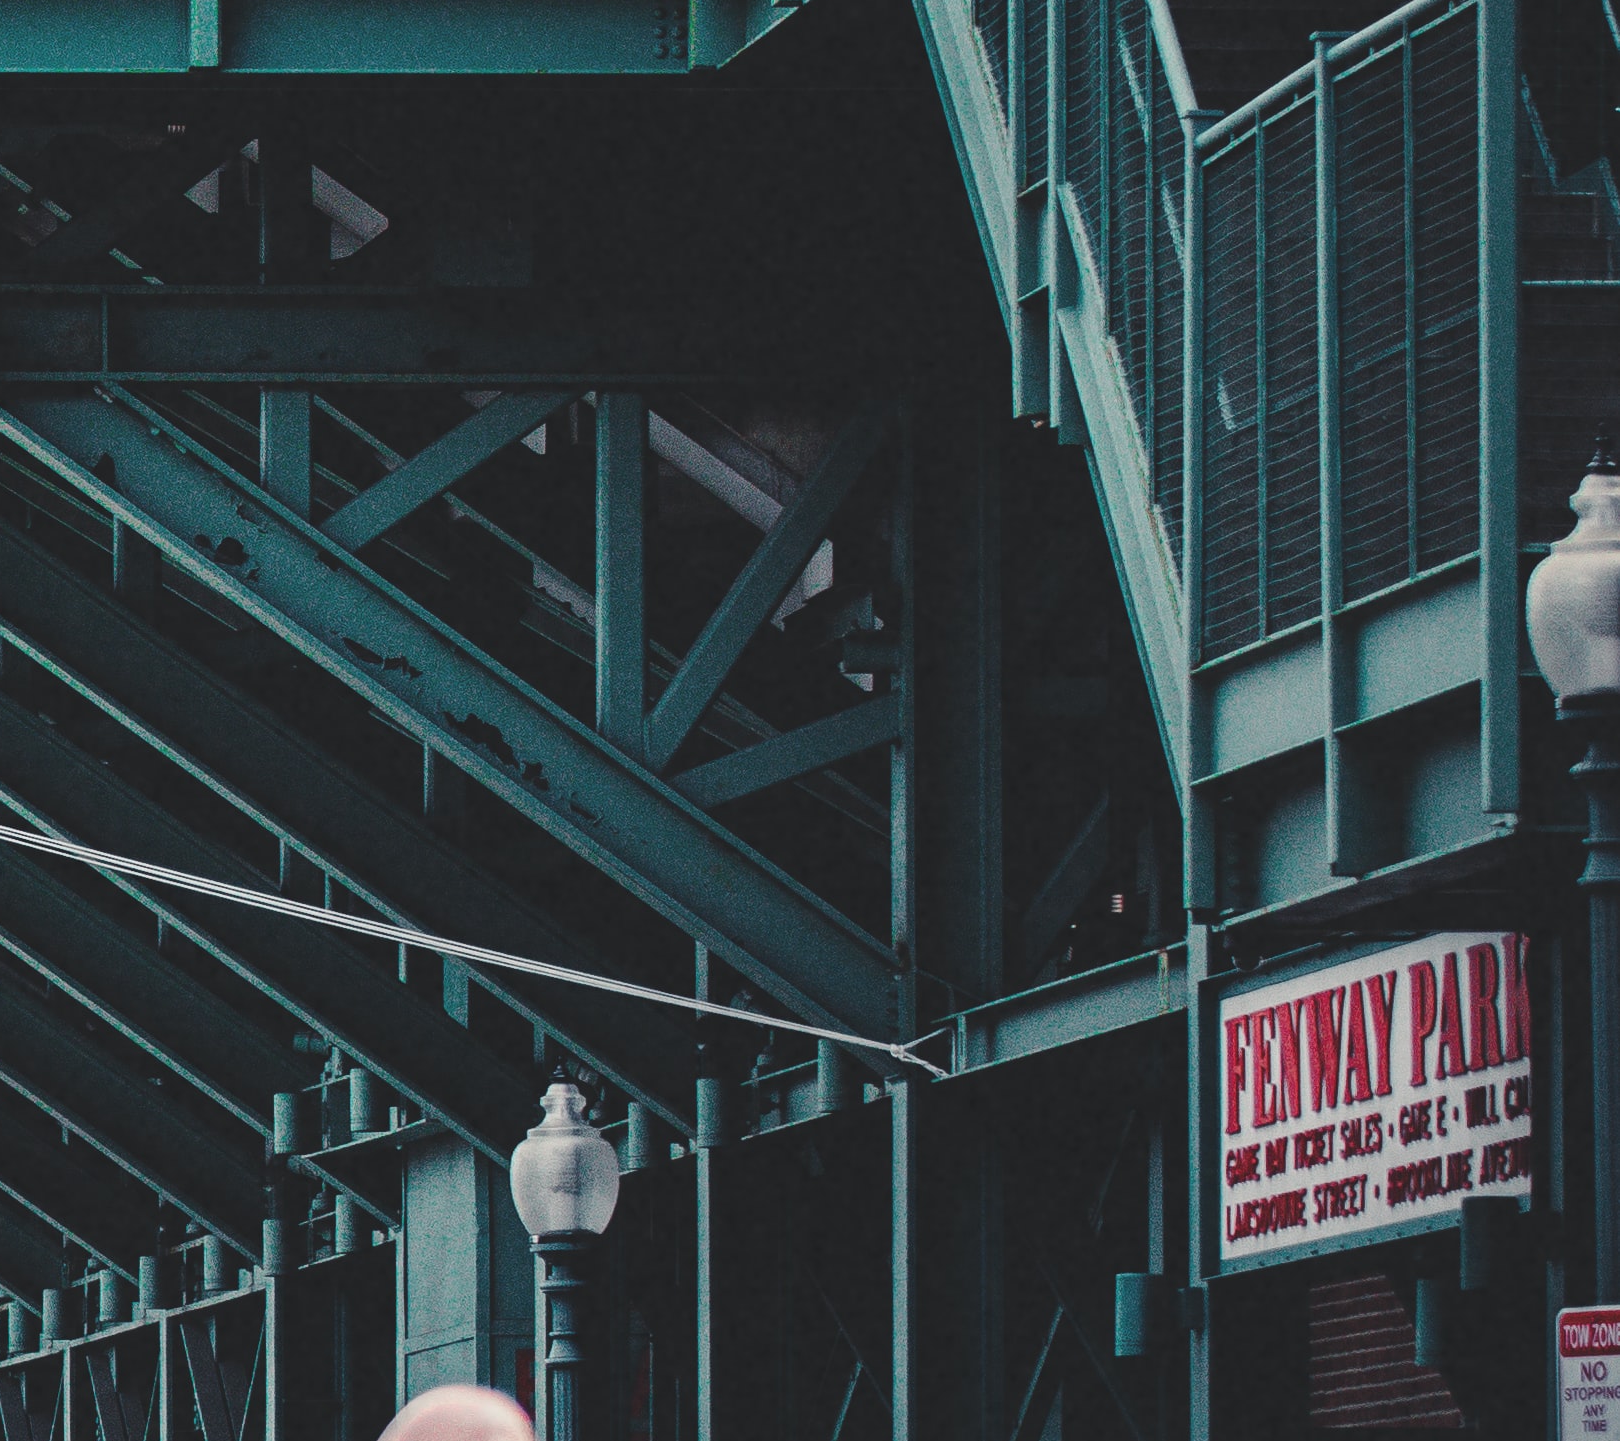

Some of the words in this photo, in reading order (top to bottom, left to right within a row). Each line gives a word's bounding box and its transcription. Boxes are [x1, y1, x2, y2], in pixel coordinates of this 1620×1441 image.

[1224, 969, 1397, 1135] FENWAY
[1408, 932, 1531, 1087] PARK
[1340, 1113, 1383, 1160] SALES
[1313, 1173, 1367, 1223] STREET
[1563, 1324, 1589, 1349] TOW
[1580, 1360, 1607, 1382] NO
[1582, 1404, 1606, 1417] ANY
[1581, 1419, 1607, 1432] TIME
